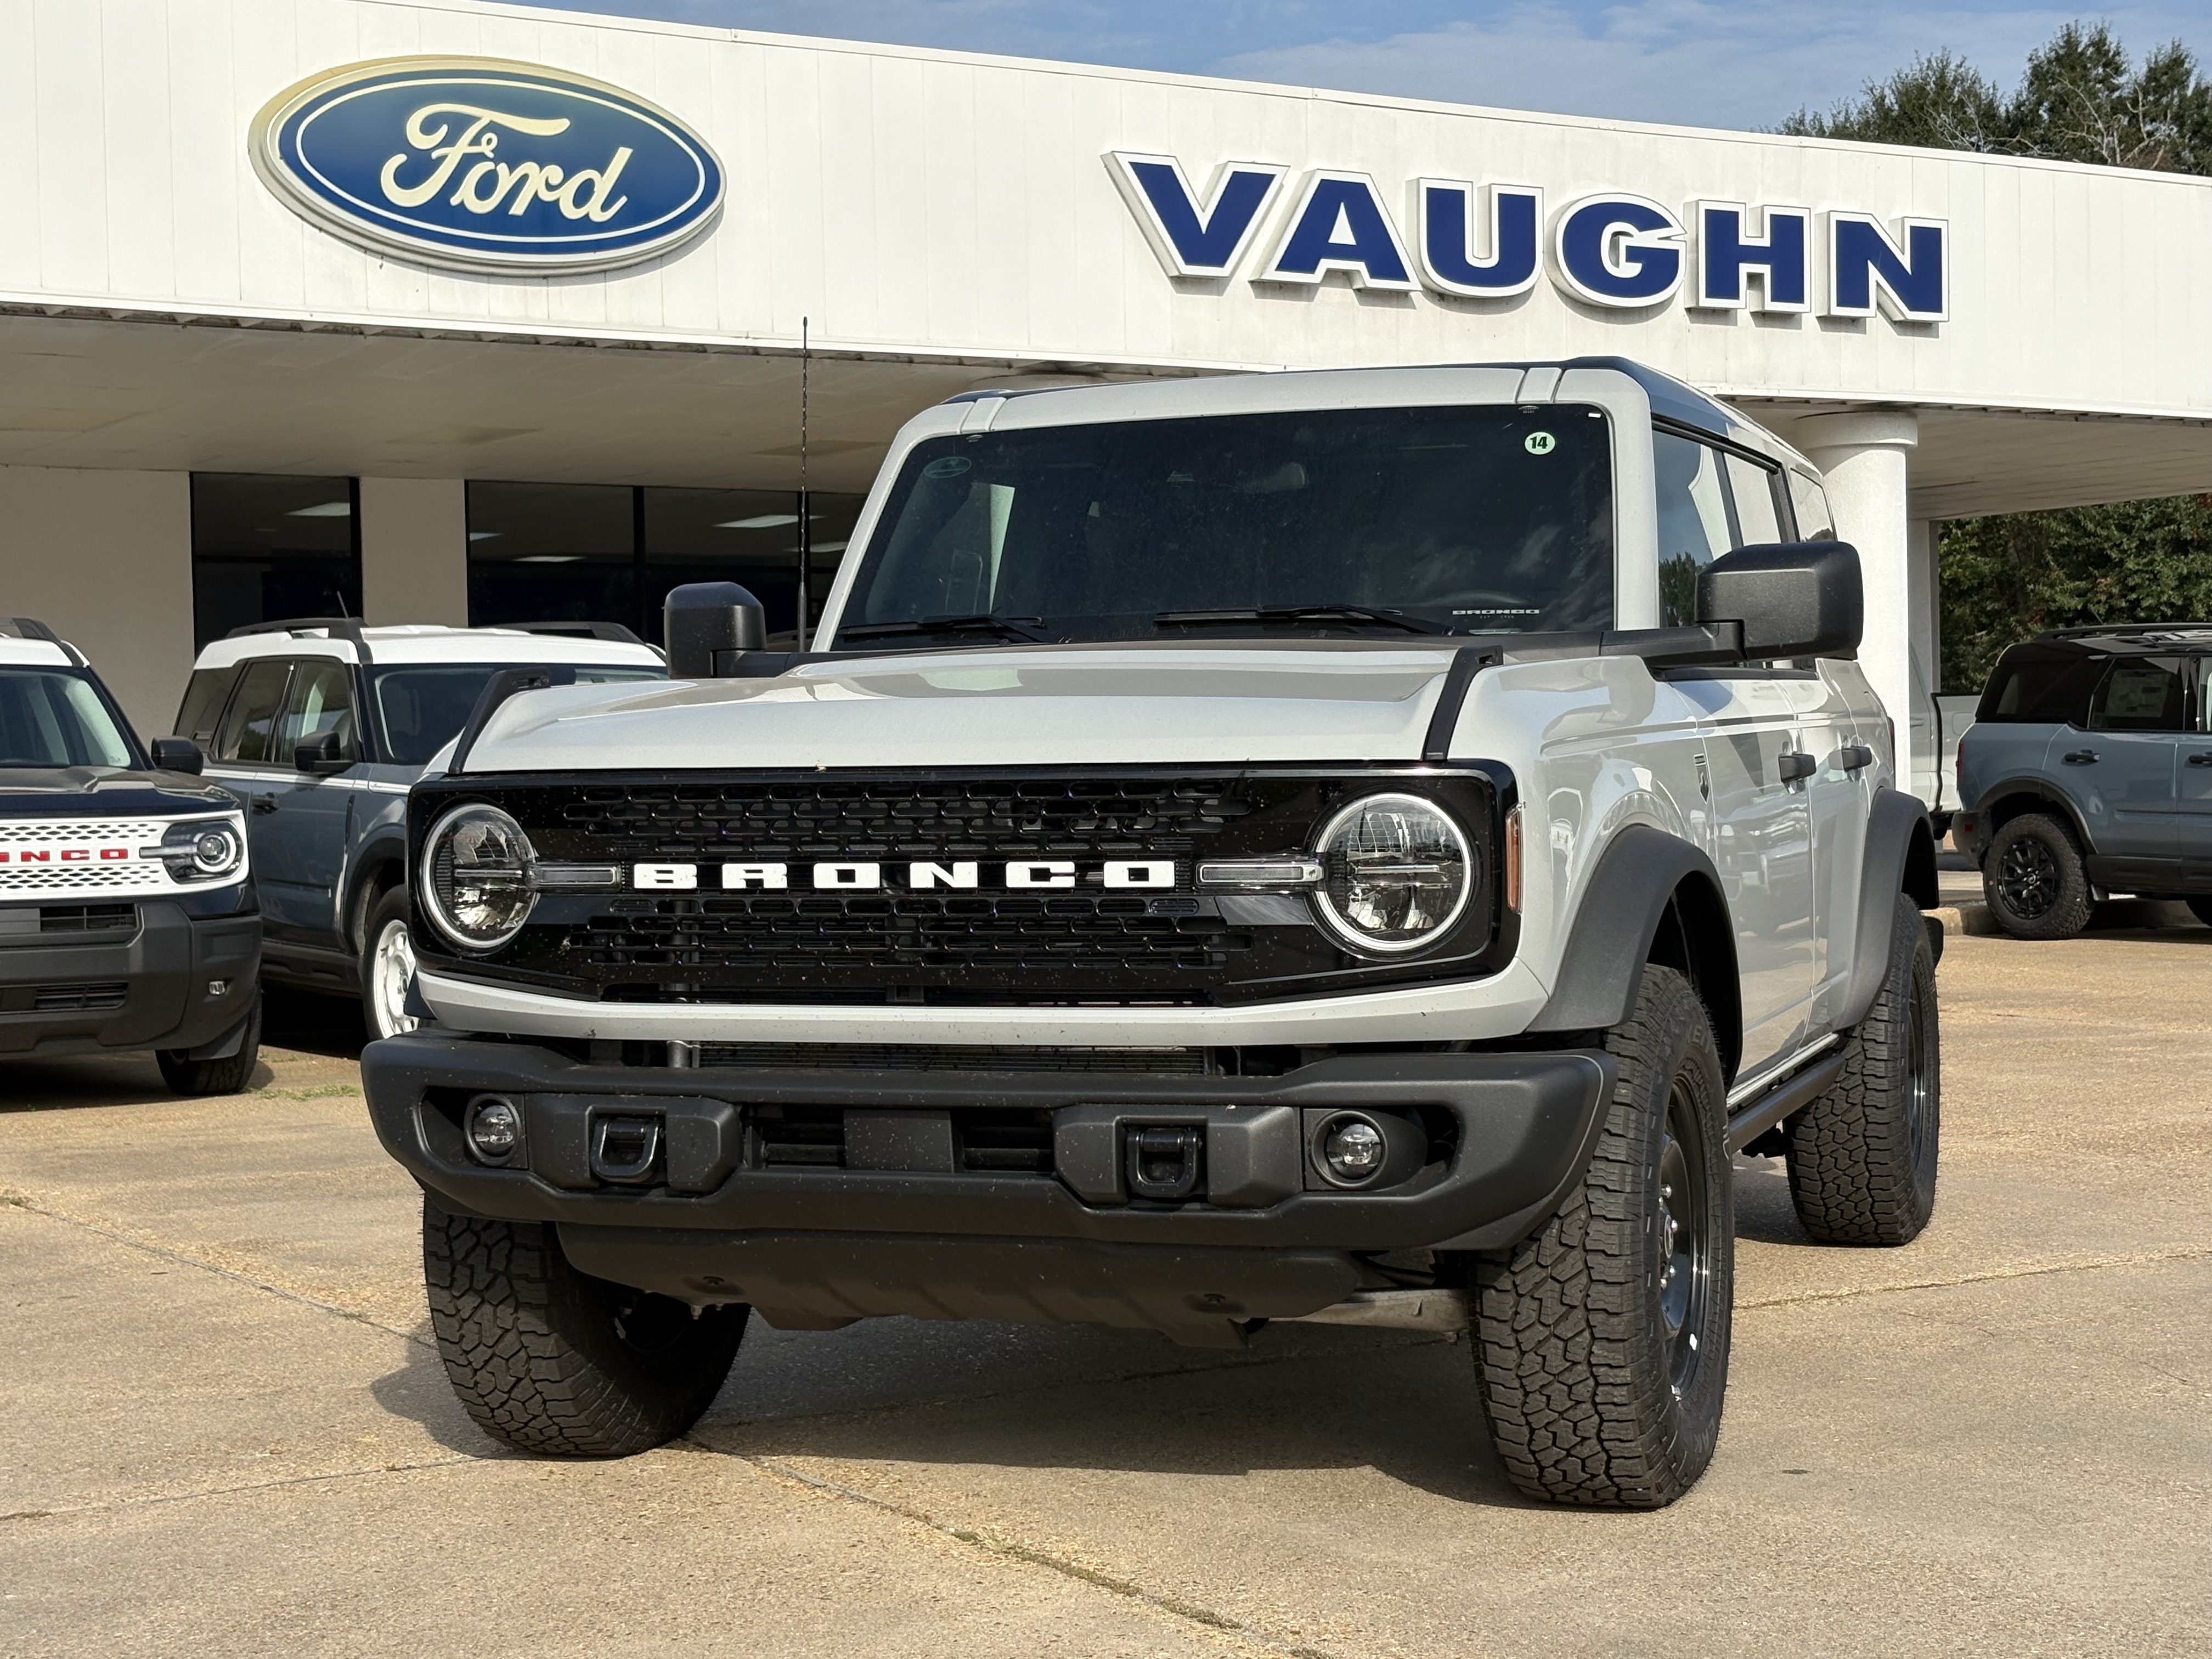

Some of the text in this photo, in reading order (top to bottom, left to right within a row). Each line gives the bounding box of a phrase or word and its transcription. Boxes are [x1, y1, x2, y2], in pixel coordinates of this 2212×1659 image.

[381, 103, 634, 222] Ford
[1107, 151, 1949, 322] VAUGHN
[1530, 436, 1548, 449] 14
[633, 861, 1175, 889] BRONCO
